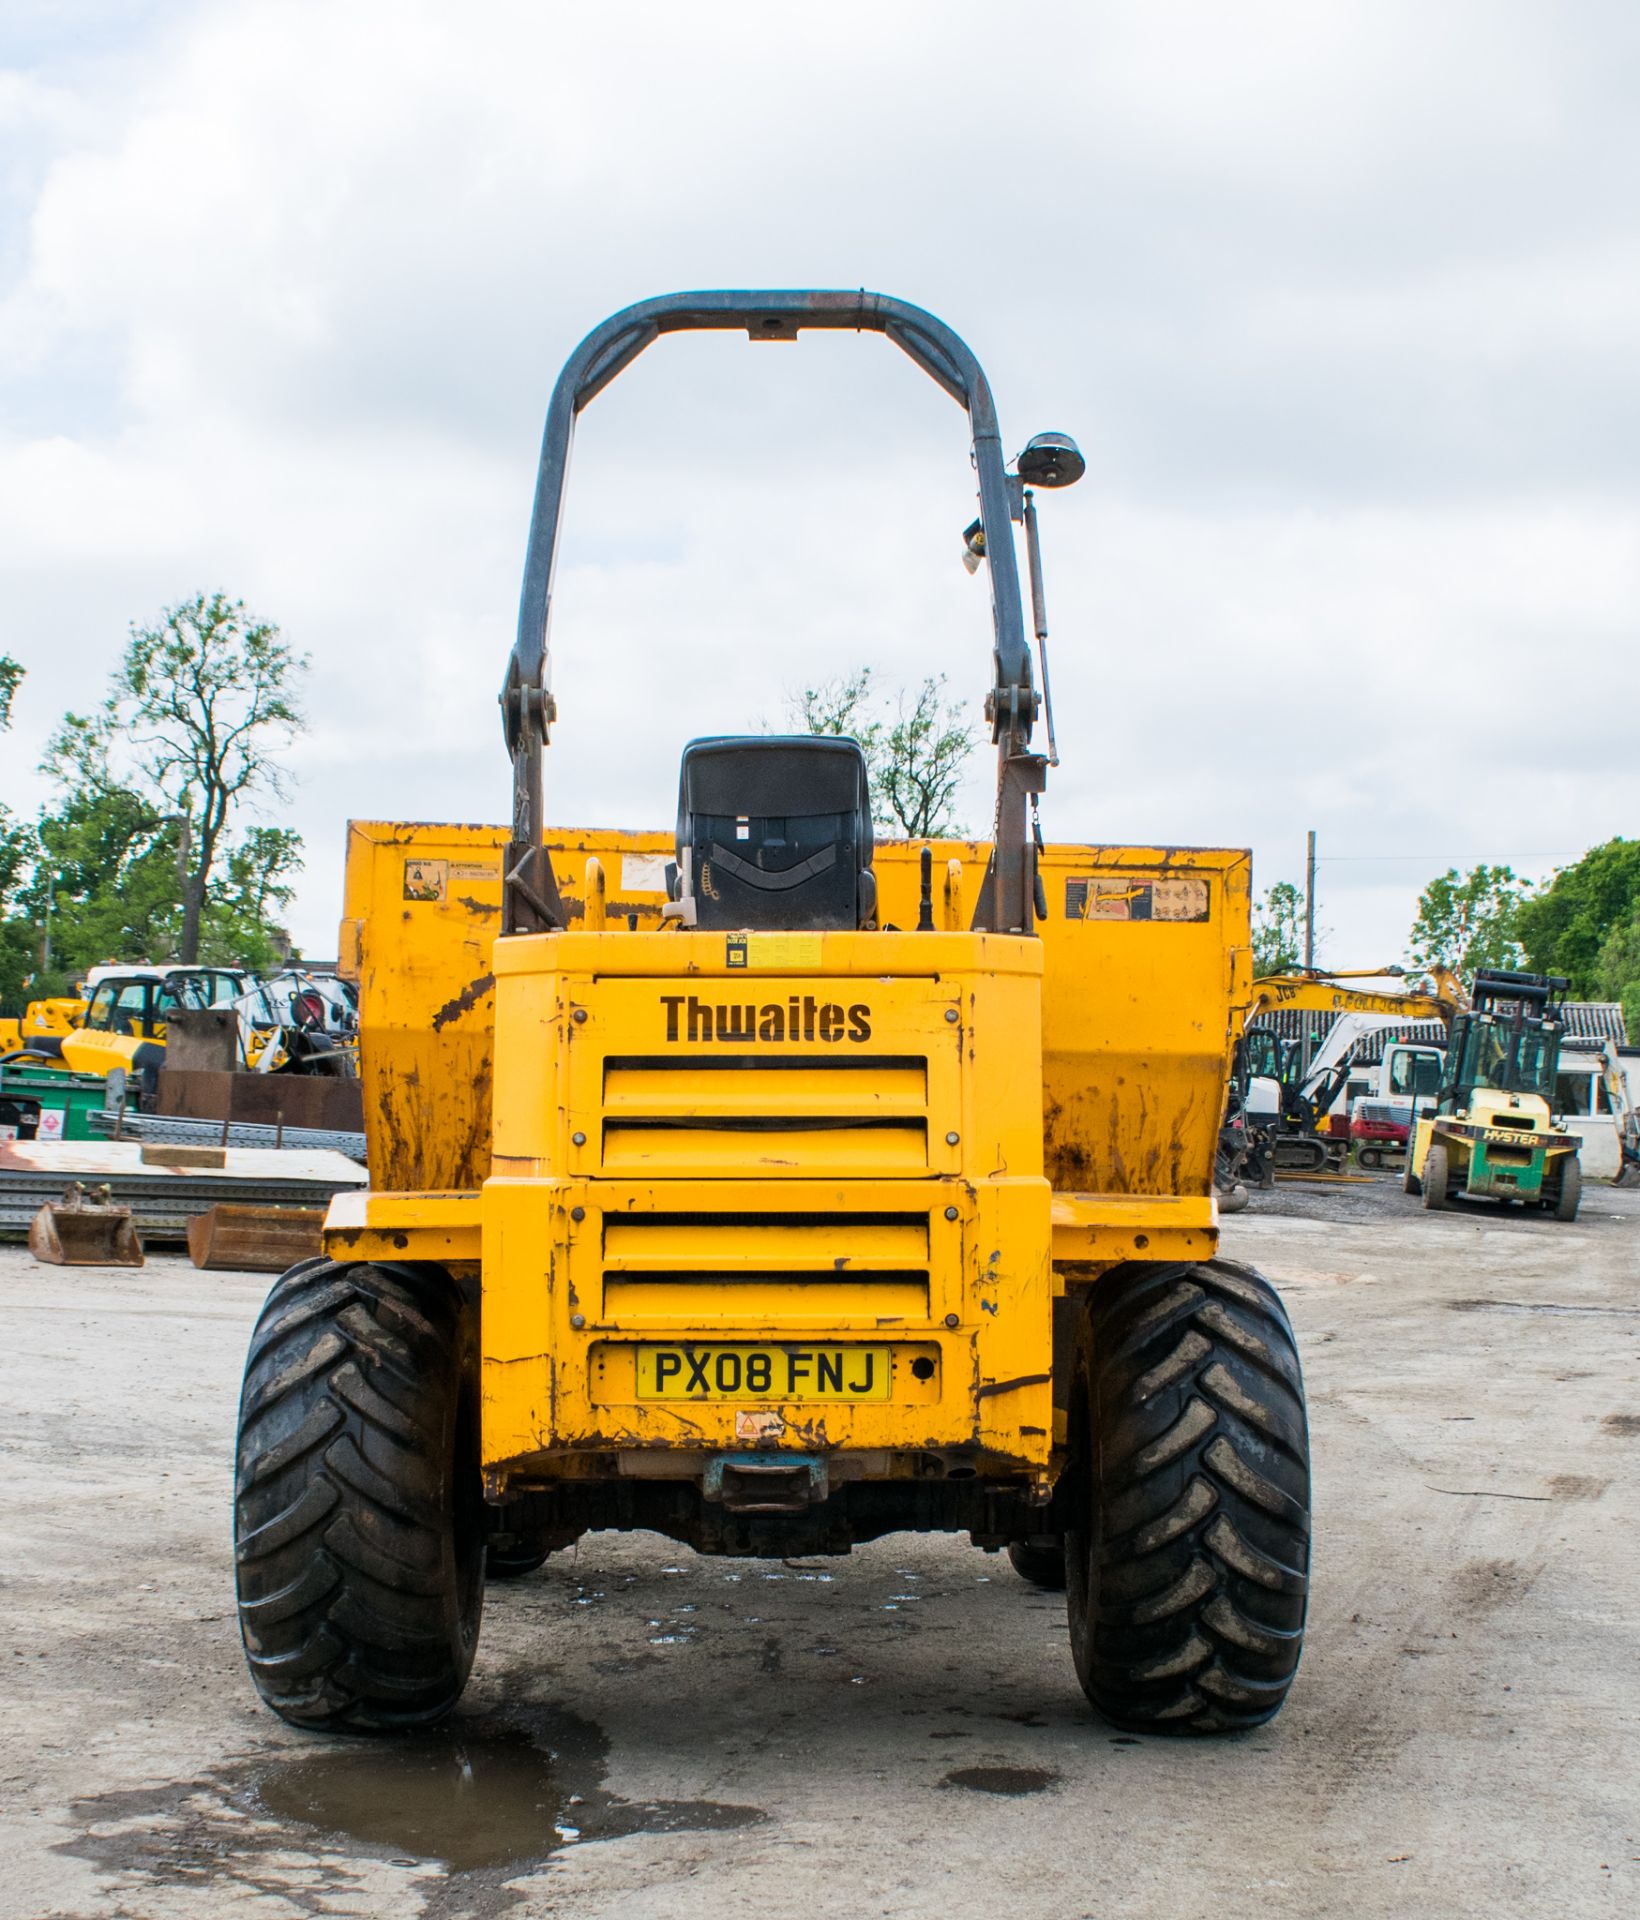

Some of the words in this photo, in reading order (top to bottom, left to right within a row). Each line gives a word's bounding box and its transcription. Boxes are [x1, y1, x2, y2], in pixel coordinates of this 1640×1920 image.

[1276, 984, 1297, 1003] JCB
[660, 996, 872, 1043] Thwaites
[1483, 1129, 1538, 1145] HYSTER
[656, 1353, 772, 1393] PX08
[788, 1353, 874, 1393] FNJ
